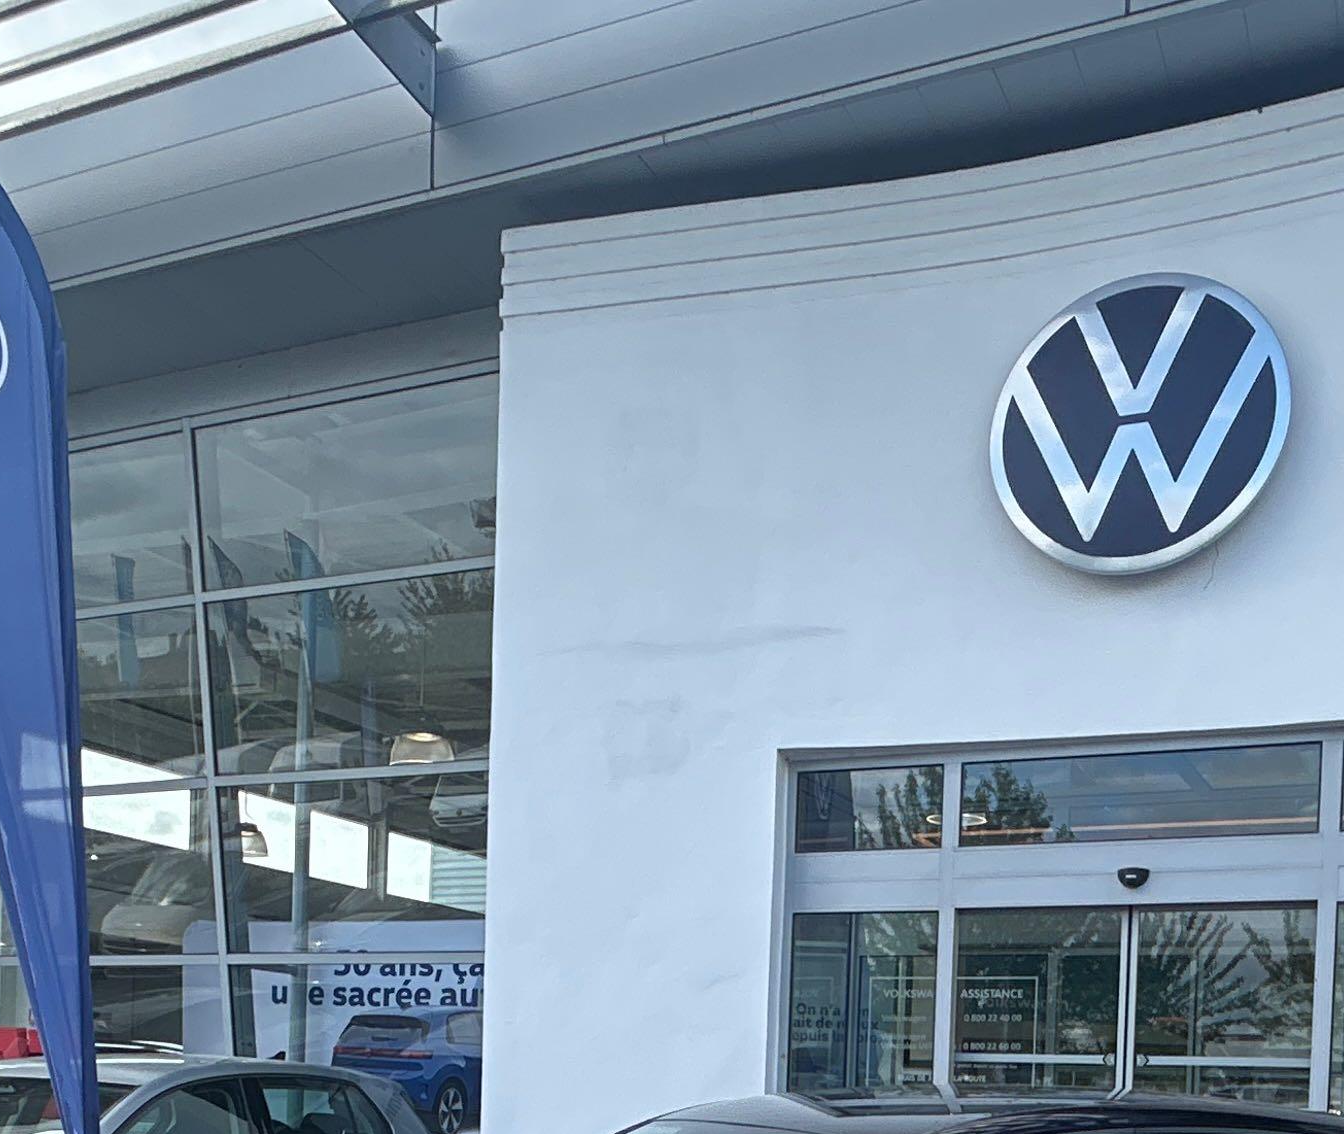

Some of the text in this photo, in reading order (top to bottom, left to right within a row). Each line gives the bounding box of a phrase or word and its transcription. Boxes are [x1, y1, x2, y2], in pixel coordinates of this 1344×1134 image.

[990, 271, 1291, 576] VW
[271, 980, 484, 1007] ue sacrée au
[960, 988, 1024, 999] ASSISTANCE
[793, 1017, 811, 1028] ait
